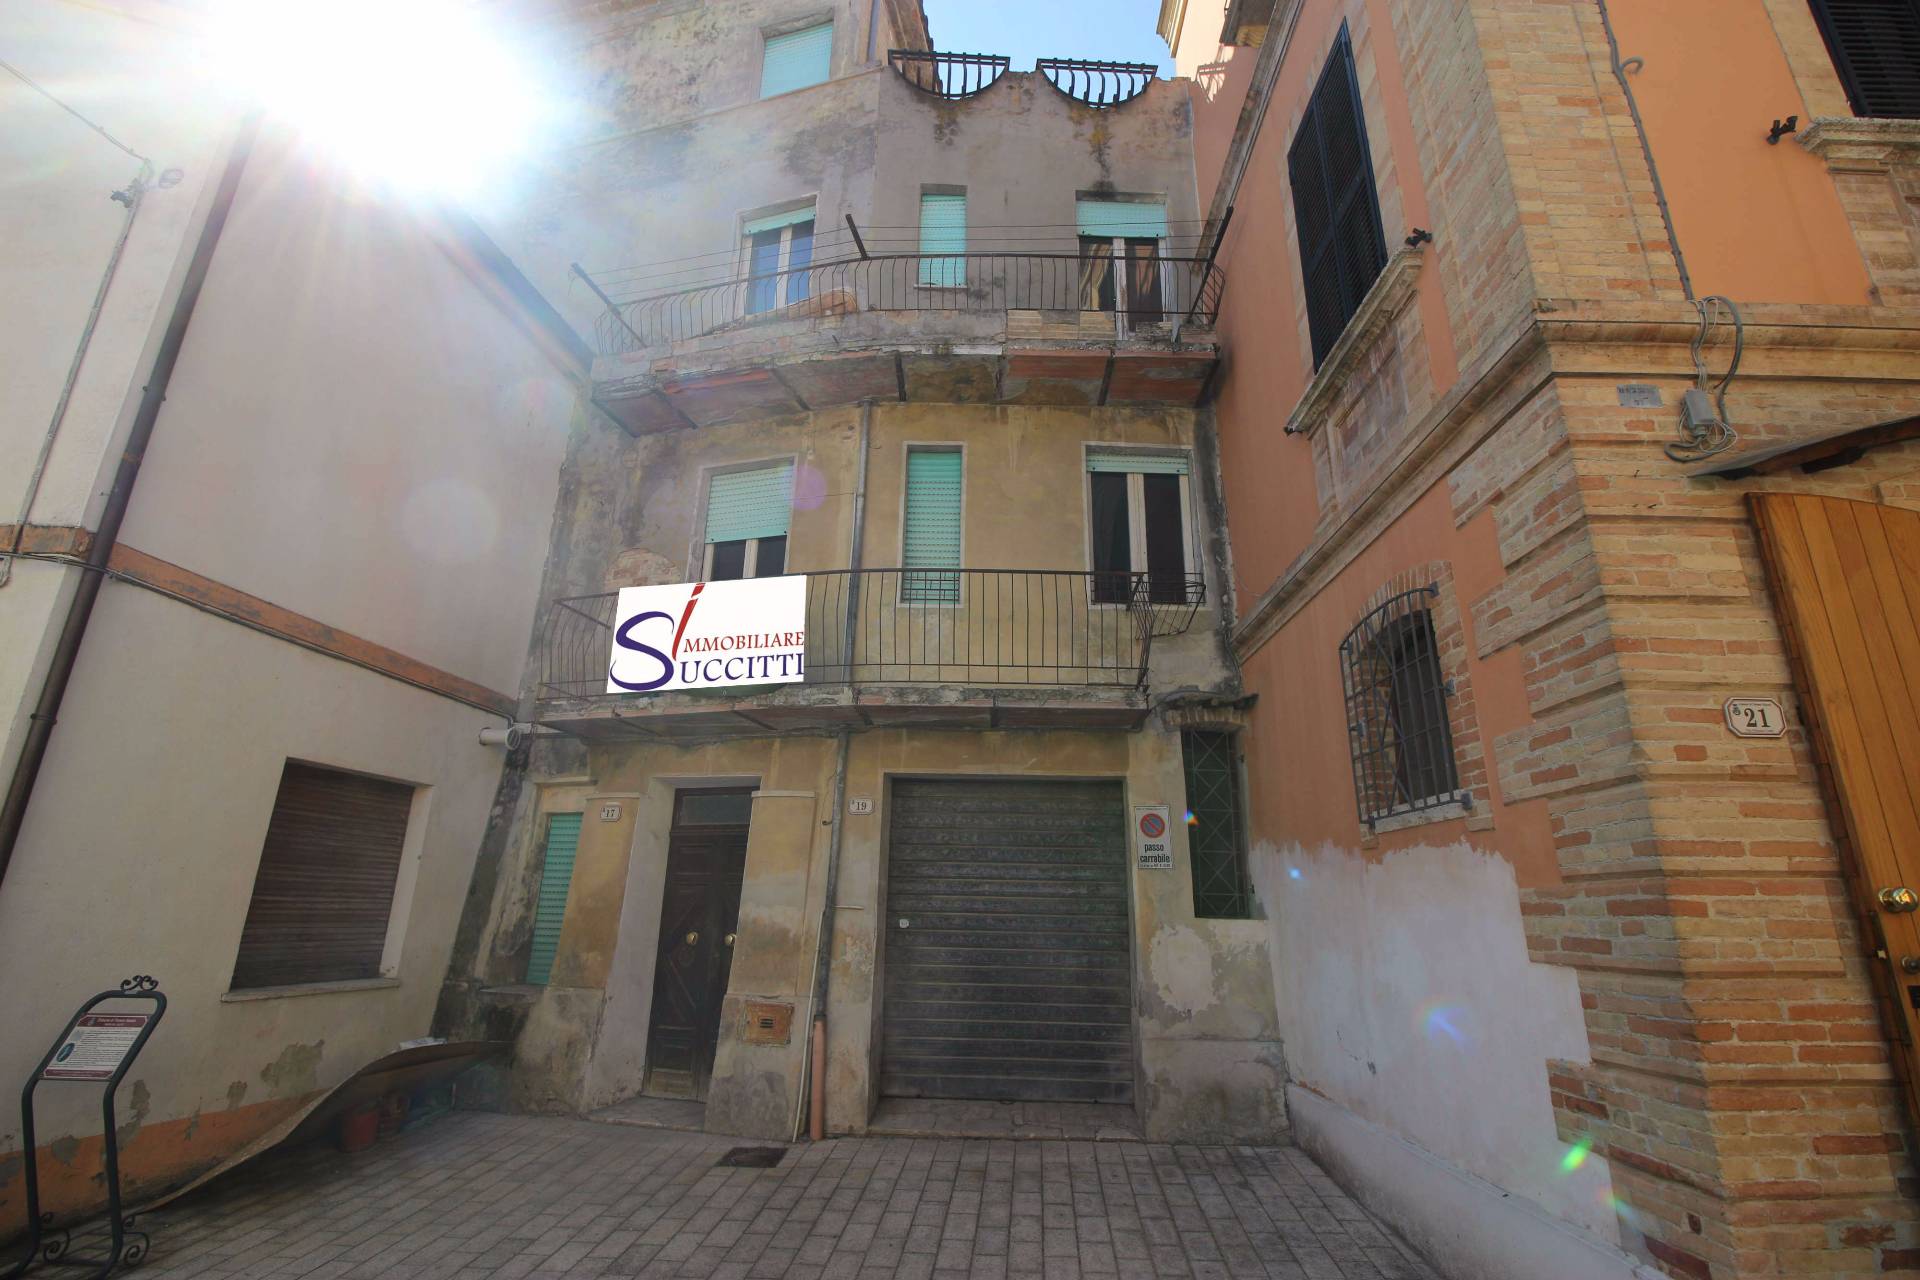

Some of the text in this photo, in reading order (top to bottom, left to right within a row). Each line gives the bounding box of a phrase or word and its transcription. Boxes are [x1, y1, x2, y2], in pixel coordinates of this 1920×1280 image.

[609, 611, 804, 691] SUCCITTI
[1743, 707, 1771, 728] 21
[856, 801, 867, 811] 19
[605, 808, 616, 818] 17
[1144, 843, 1165, 853] passo
[1140, 854, 1170, 863] carrabile
